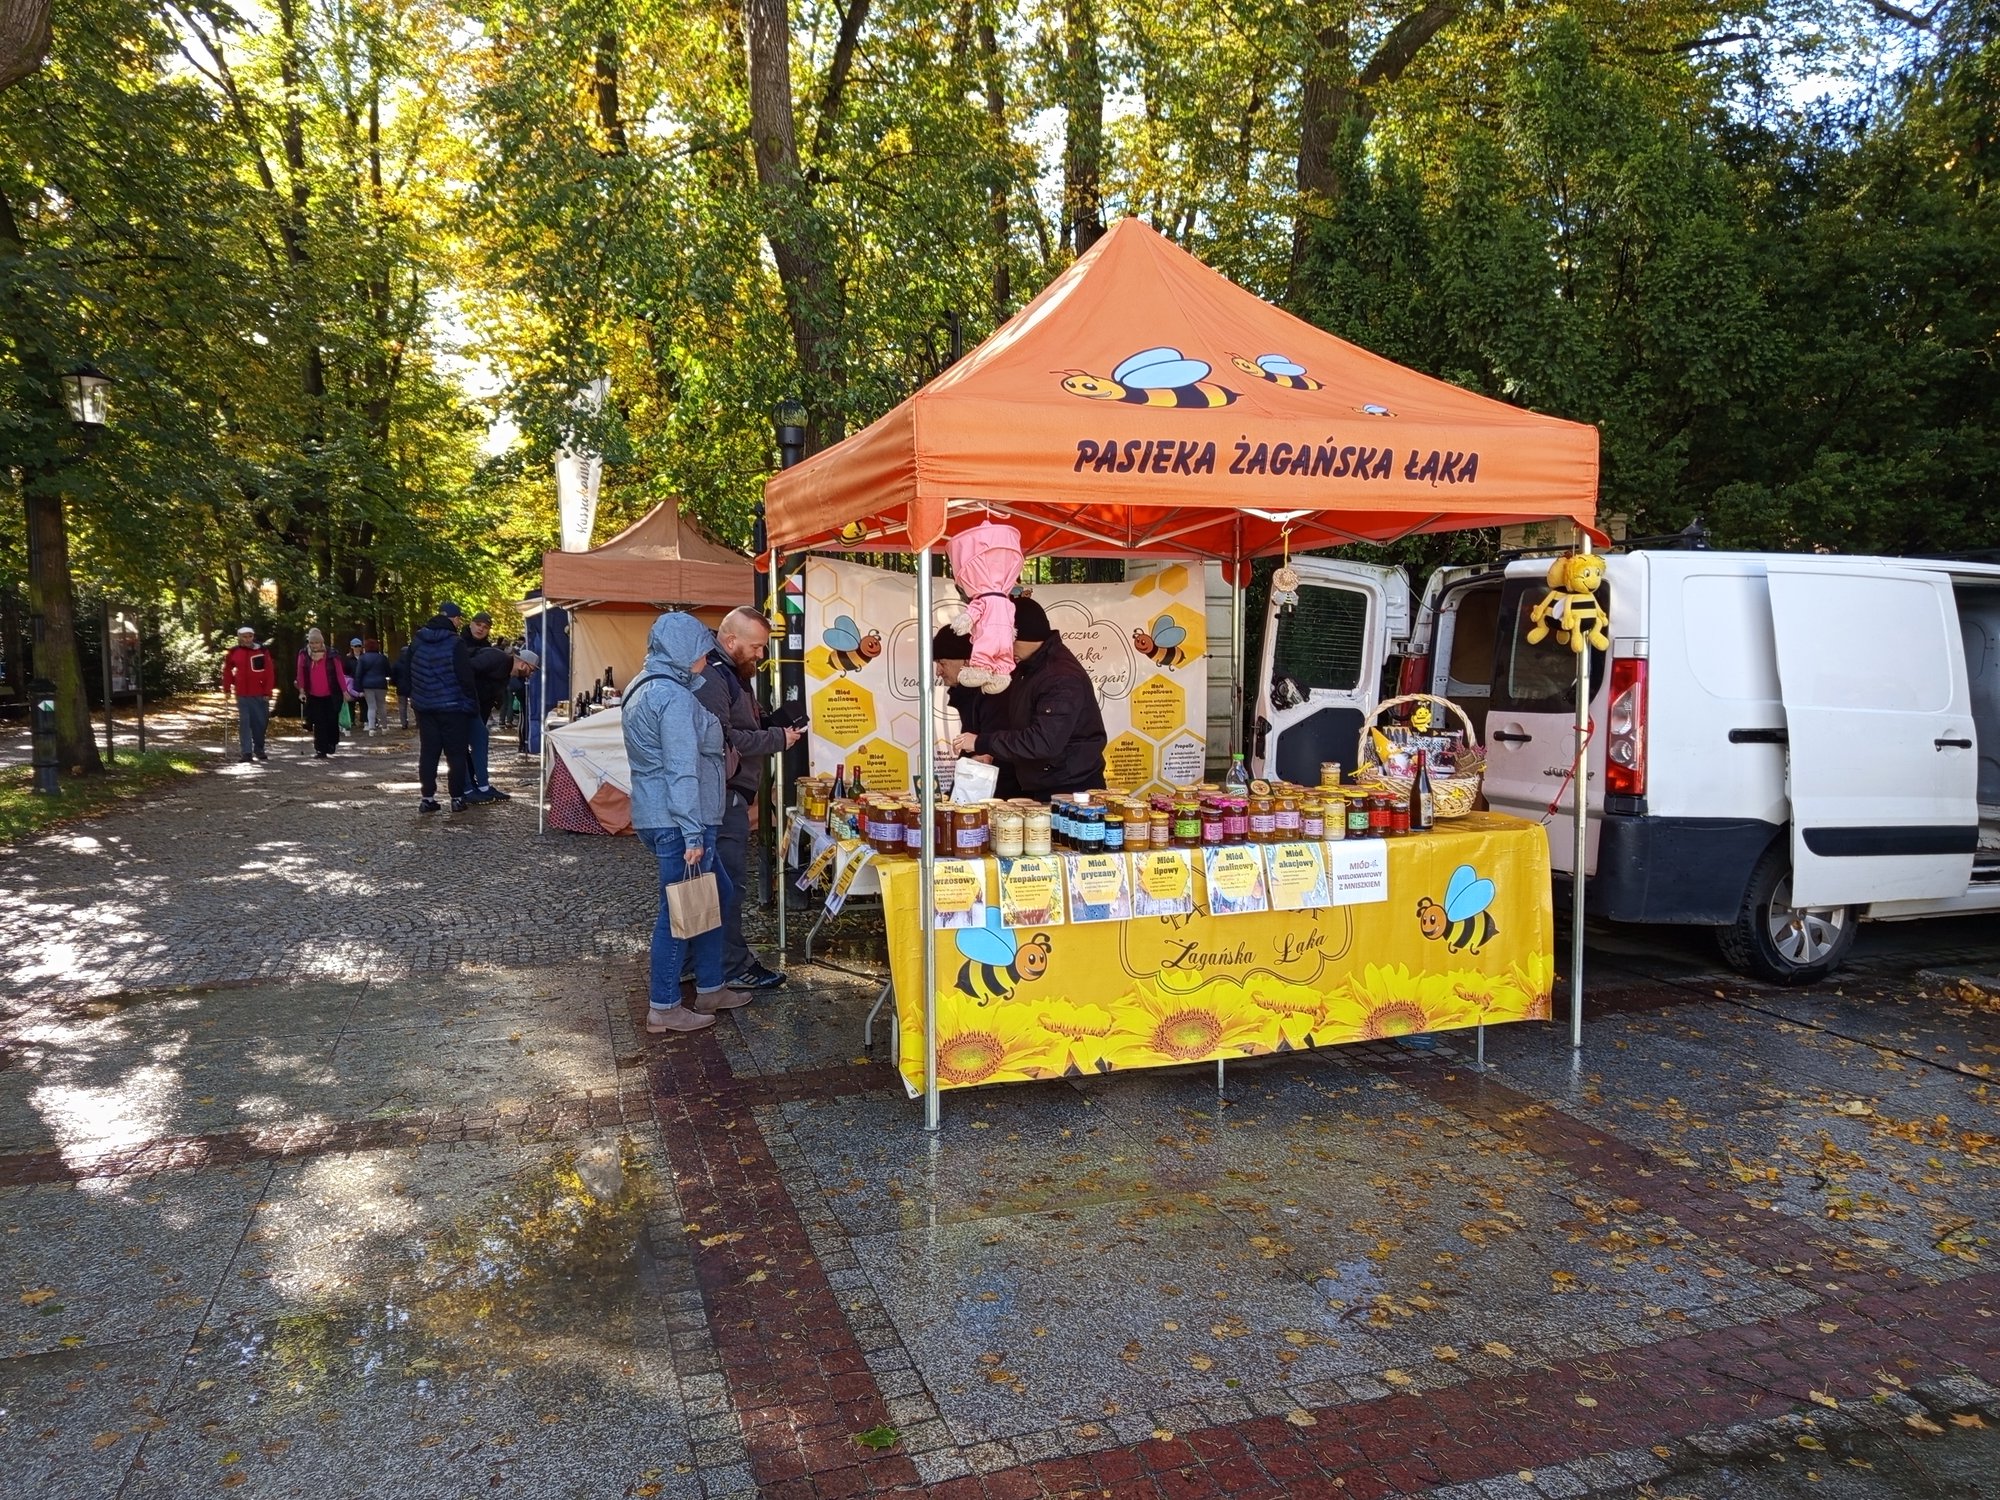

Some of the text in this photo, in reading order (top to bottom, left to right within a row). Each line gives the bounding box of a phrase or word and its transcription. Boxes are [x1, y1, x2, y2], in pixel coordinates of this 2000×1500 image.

[1073, 434, 1479, 488] PASIEKA ŻAGAŃSKA ŁĄKA
[1157, 856, 1175, 864] Miód
[1279, 860, 1313, 868] akacjowy
[1349, 860, 1370, 870] MIÓD
[1154, 867, 1178, 876] lipowy
[1218, 863, 1253, 871] malinowy
[1010, 875, 1053, 884] rzepakowy
[1081, 870, 1116, 880] gryczany
[1337, 871, 1382, 881] WIELOKWIATOWY
[1344, 880, 1380, 890] MNISZKIEM
[1161, 928, 1328, 970] Żagańska Łąka
